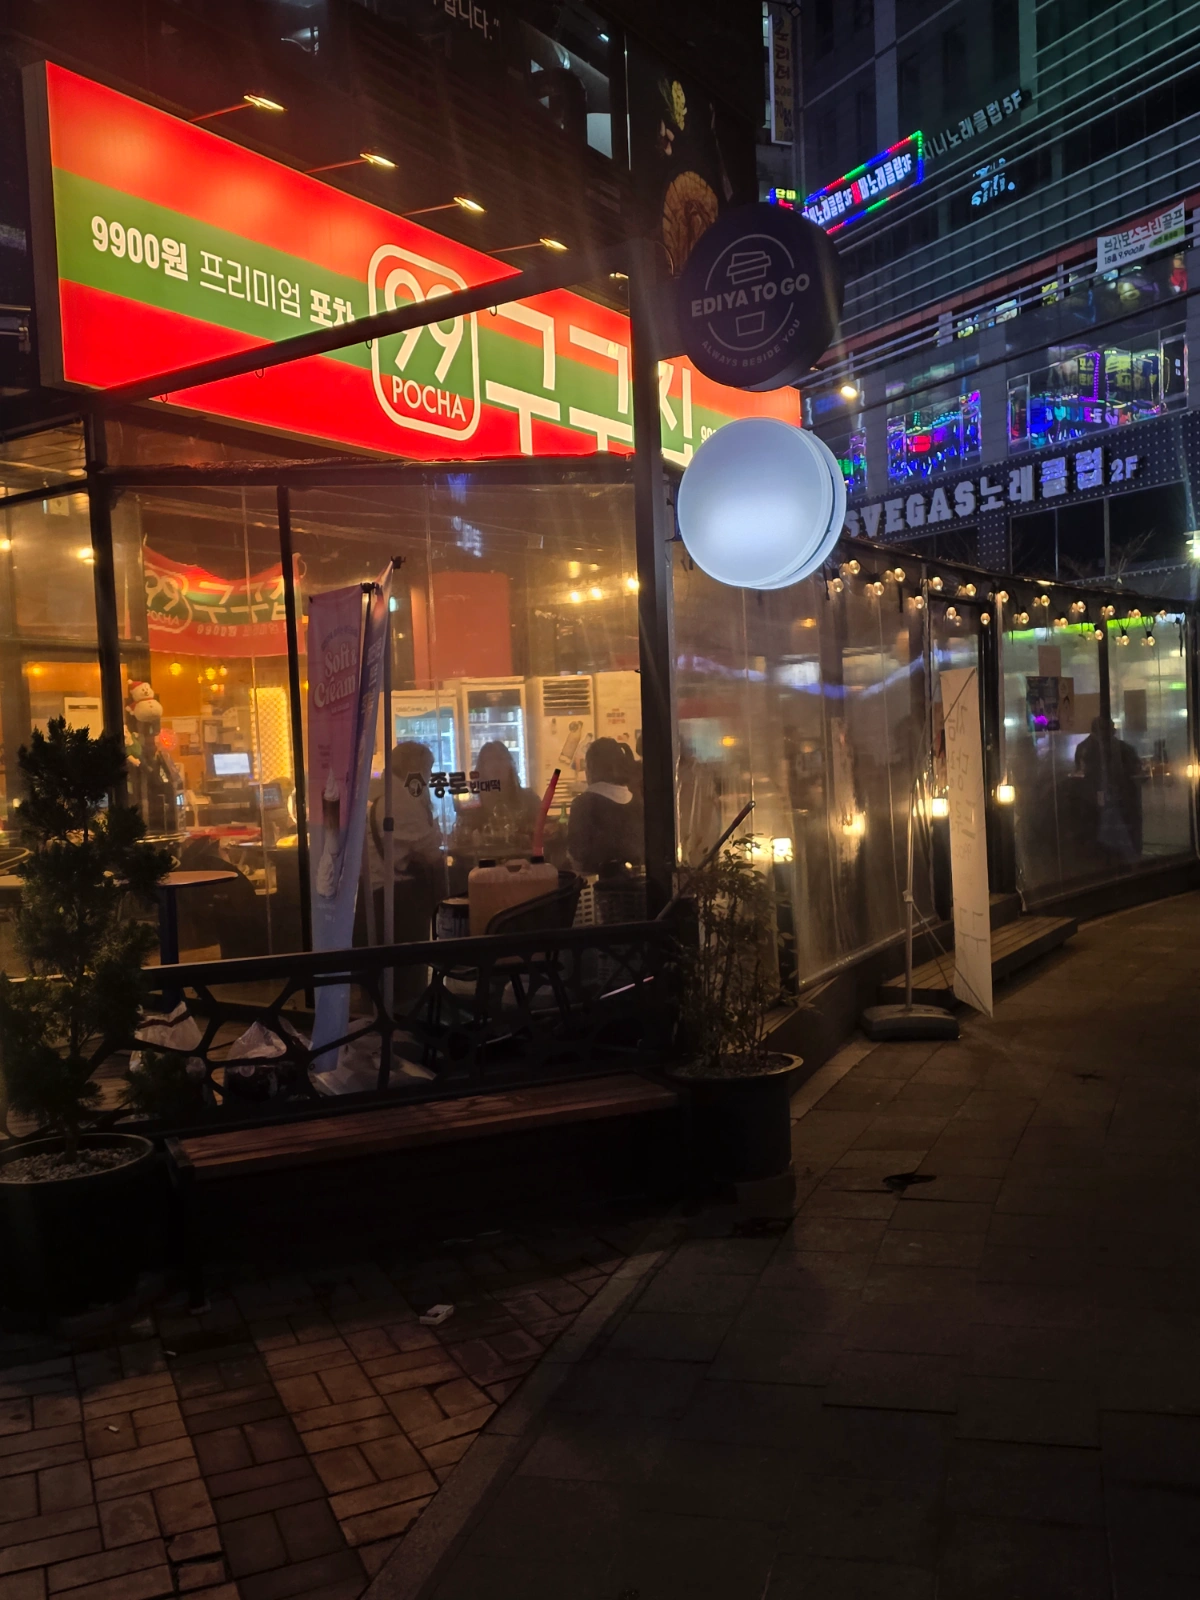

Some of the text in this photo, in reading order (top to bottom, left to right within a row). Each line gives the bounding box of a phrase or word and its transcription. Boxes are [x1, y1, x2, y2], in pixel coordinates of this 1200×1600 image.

[1002, 89, 1022, 115] 5F
[91, 215, 356, 328] 9900원 프리미엄 포차
[691, 273, 811, 318] EDIYA TO GO
[384, 268, 464, 384] 99
[701, 318, 801, 368] ALWAYS BESIDE YOU
[392, 375, 466, 422] POCHA
[1110, 455, 1138, 482] 2F
[428, 772, 501, 798] 종로 빈대떡
